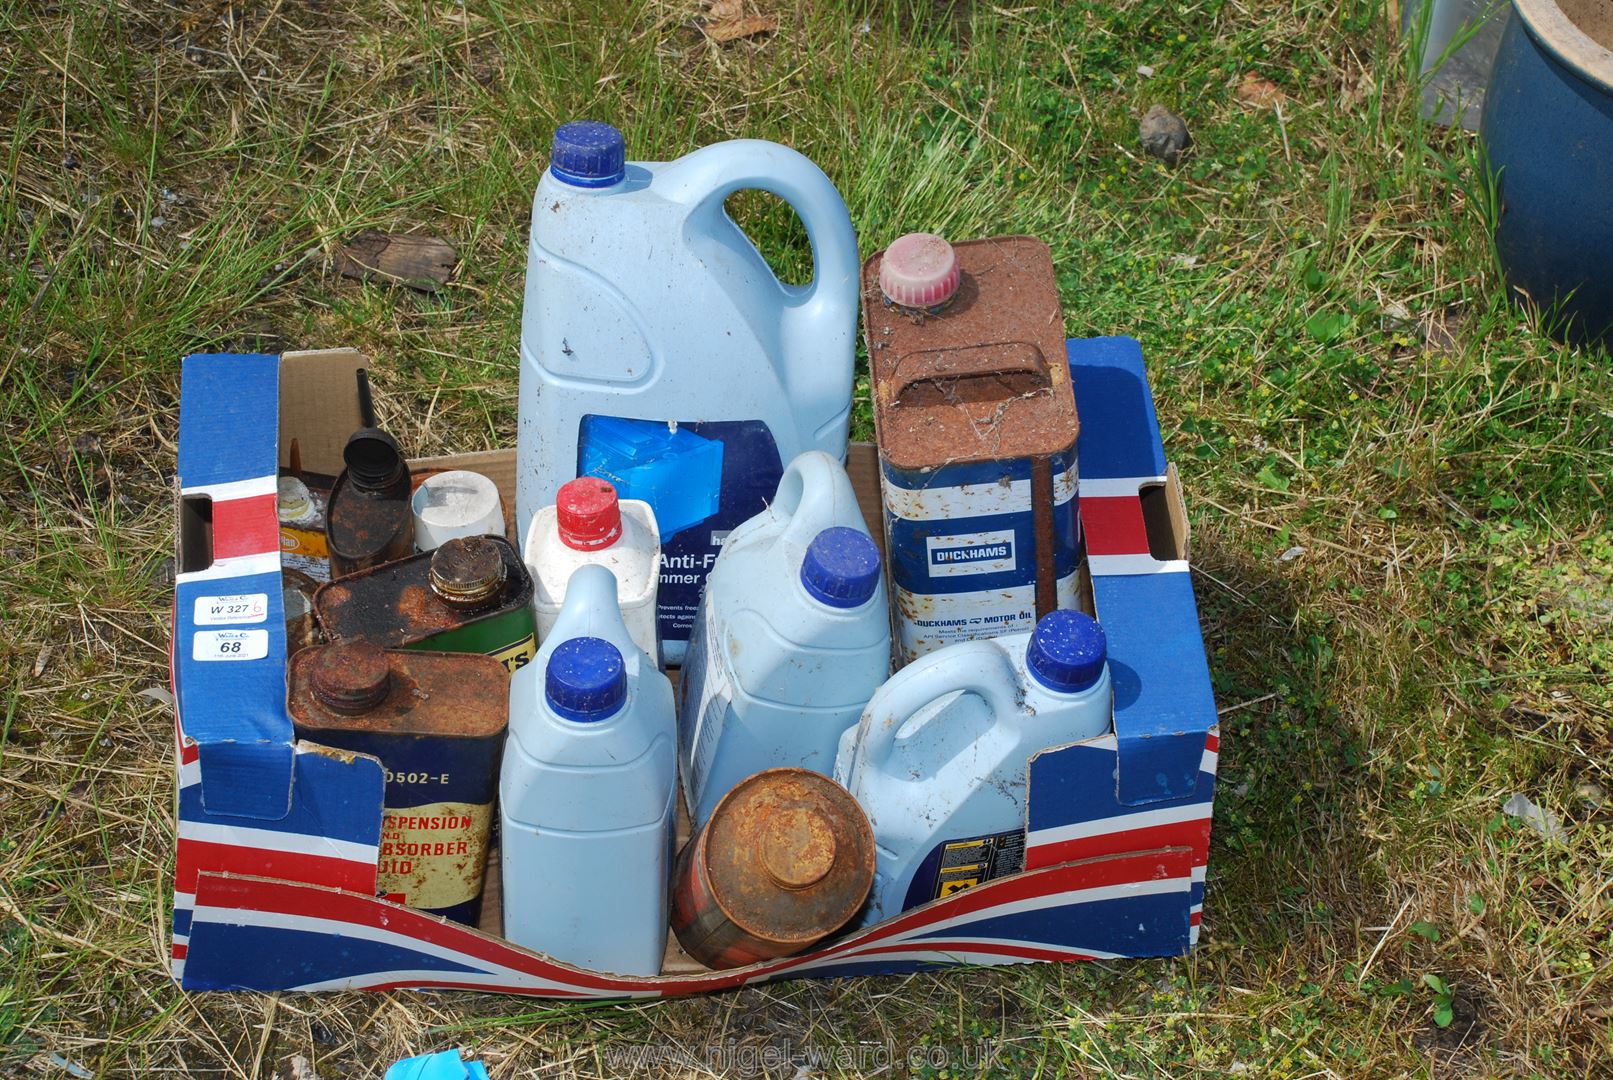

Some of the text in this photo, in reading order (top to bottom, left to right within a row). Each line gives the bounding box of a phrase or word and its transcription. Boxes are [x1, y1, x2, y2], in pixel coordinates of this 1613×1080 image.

[936, 546, 1007, 562] DUCKHAMS
[211, 604, 249, 614] W 327
[917, 611, 1033, 628] DUCKHAMS MOTOR OIL
[220, 641, 242, 653] 68
[382, 815, 472, 830] SPENSION
